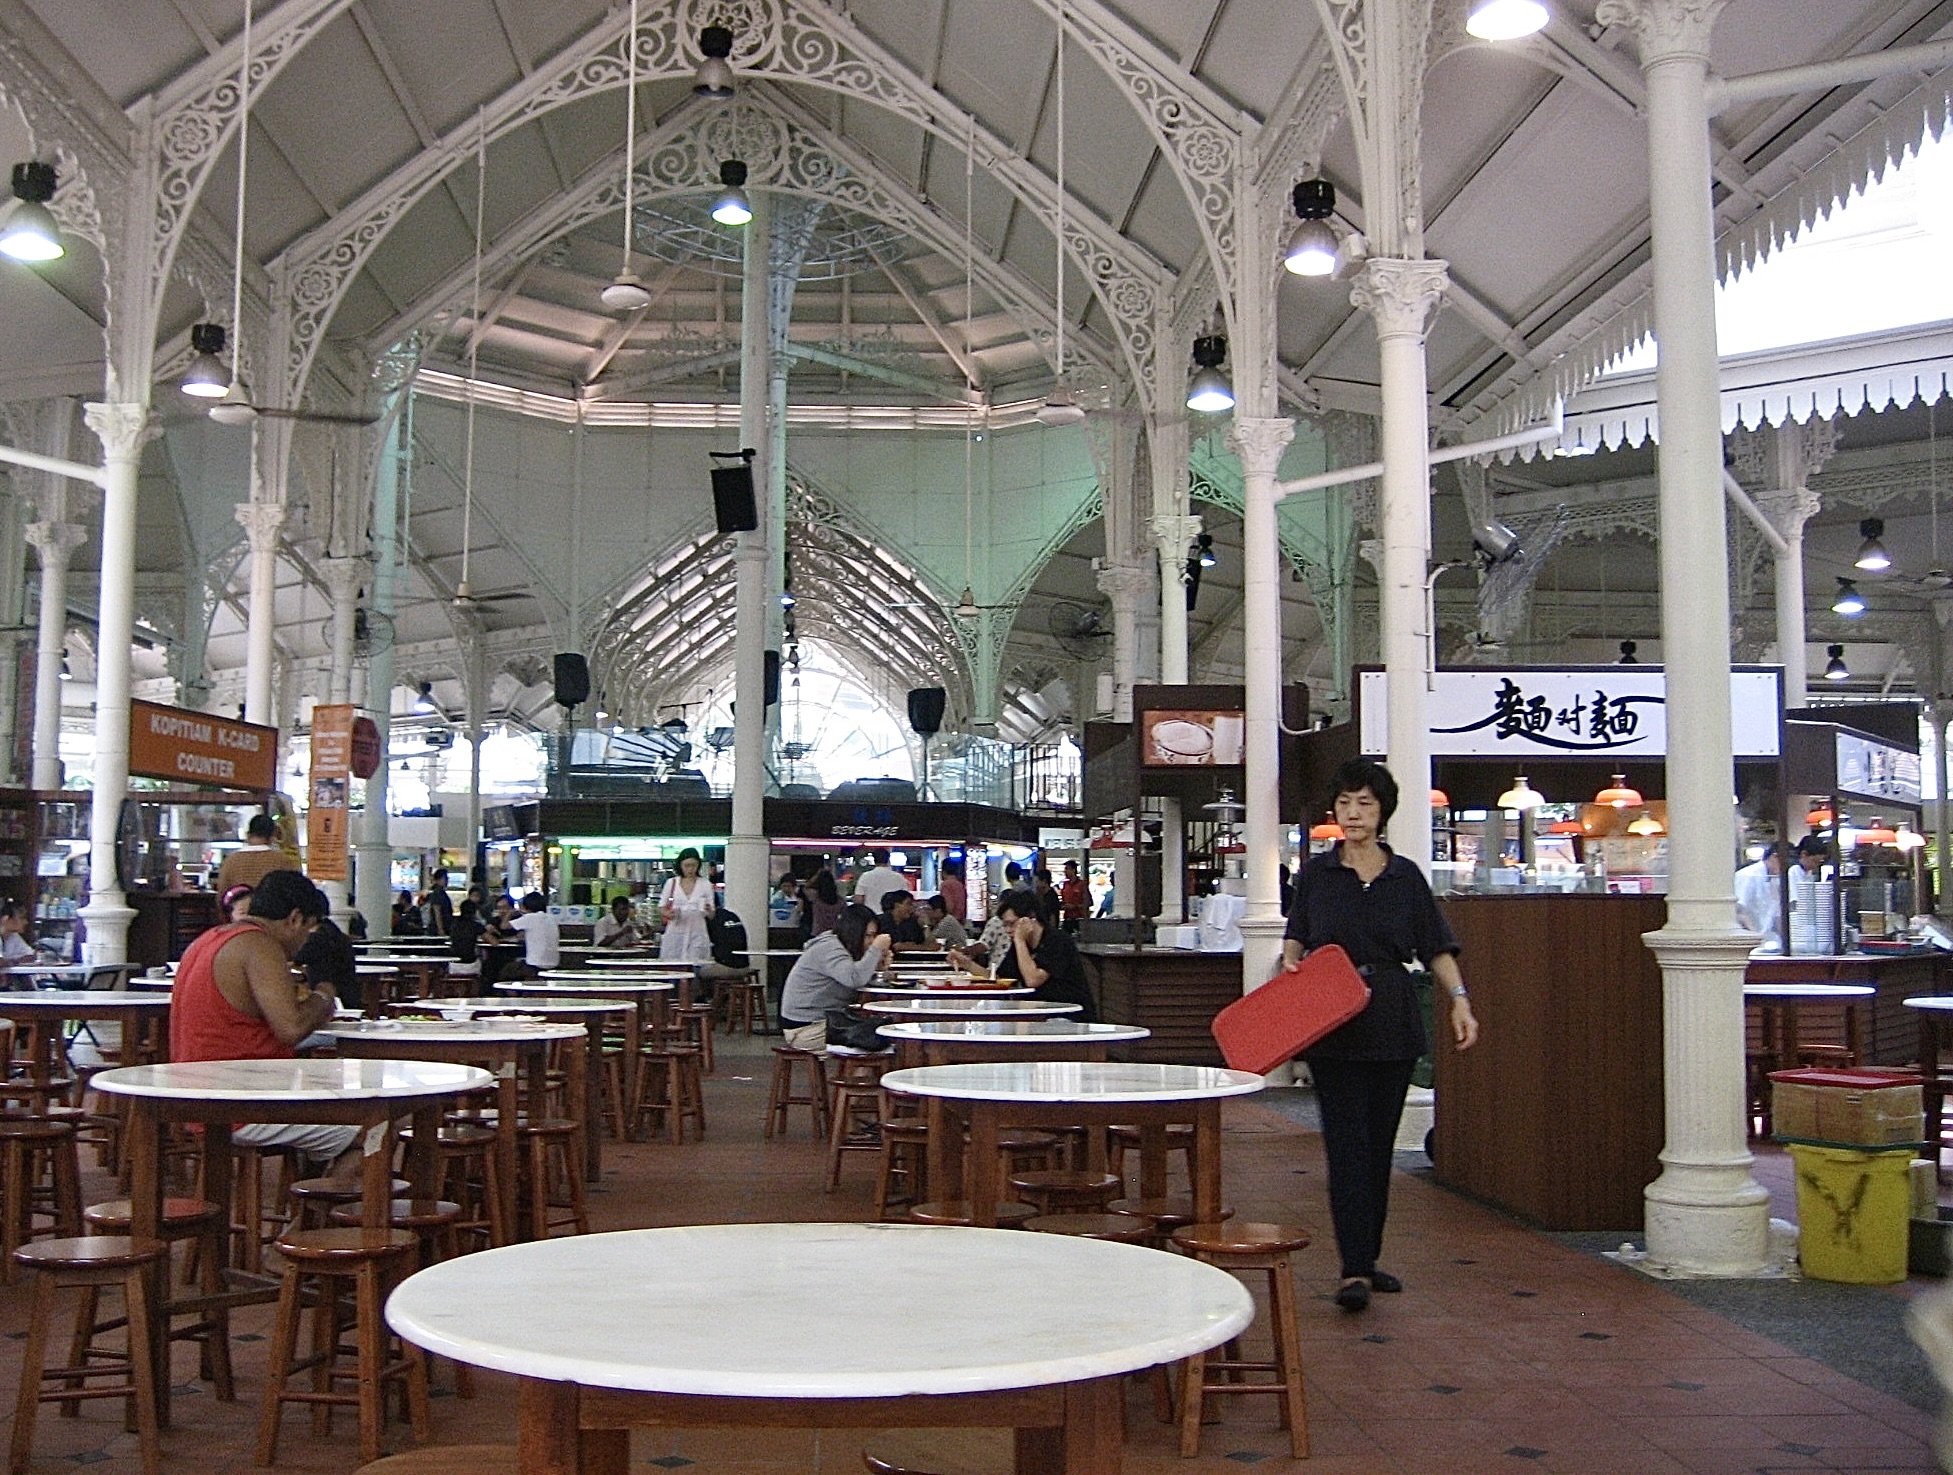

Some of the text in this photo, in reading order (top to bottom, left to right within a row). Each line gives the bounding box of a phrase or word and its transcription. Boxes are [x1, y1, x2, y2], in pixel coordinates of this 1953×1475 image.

[150, 713, 260, 752] KOPITIAM K-CARD
[176, 752, 236, 779] COUNTER
[831, 825, 900, 838] BEVERAGE
